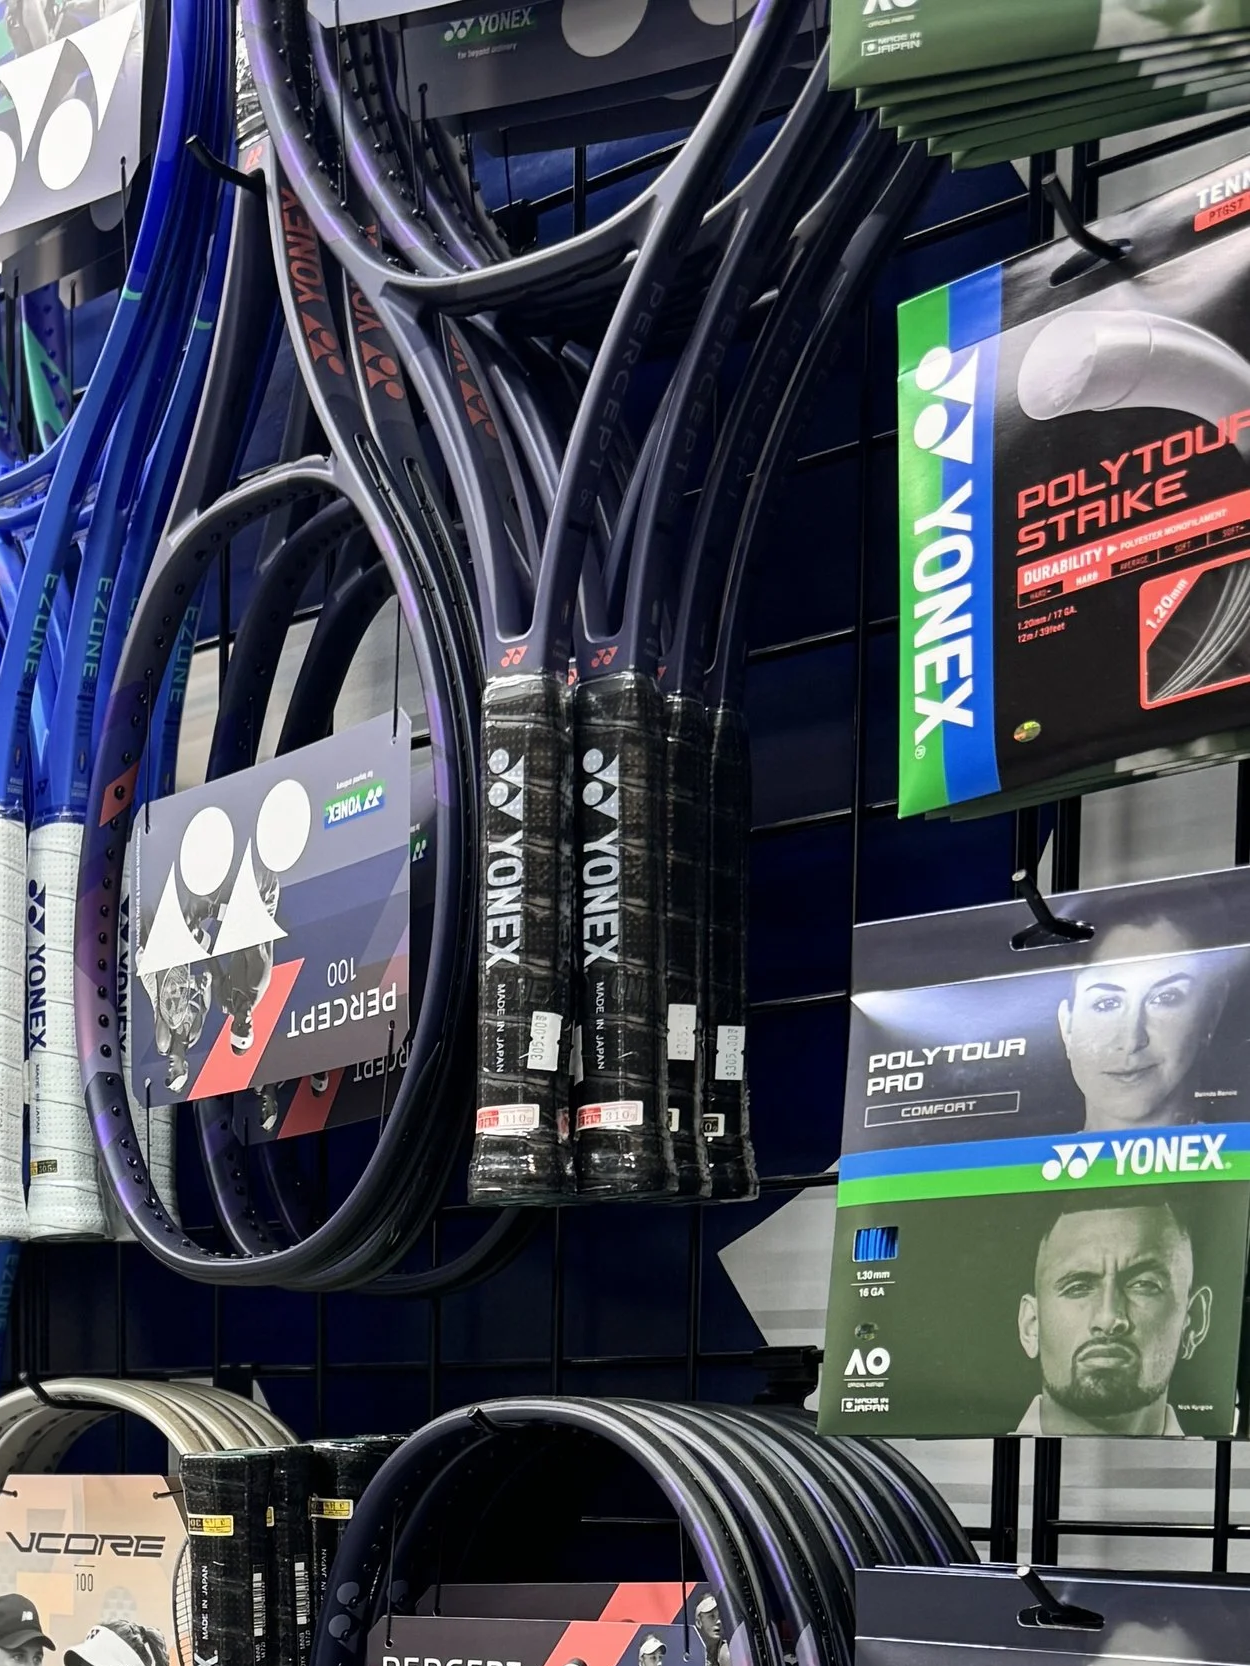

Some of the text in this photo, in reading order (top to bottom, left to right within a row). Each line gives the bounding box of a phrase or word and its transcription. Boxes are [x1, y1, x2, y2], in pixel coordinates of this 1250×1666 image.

[478, 7, 533, 35] YONEX
[878, 38, 921, 53] JAPAN
[589, 281, 666, 477] PERCEPT
[1016, 470, 1188, 556] STRIKE
[1023, 509, 1228, 586] DURABILITY POLYESTER MONOFILAMENT
[1075, 570, 1098, 586] HARD
[914, 479, 974, 742] YONEX
[1146, 577, 1188, 630] 1.20mm
[24, 573, 59, 674] EZONE
[83, 577, 113, 678] EZONE
[326, 793, 362, 824] YONEX
[486, 830, 524, 967] YONEX
[582, 830, 620, 967] YONEX
[328, 957, 356, 988] 100
[29, 943, 47, 1050] YONEX
[287, 982, 397, 1038] PERCEPT
[496, 983, 505, 1073] MADE IN JAPAN
[596, 982, 605, 1070] MADE IN JAPAN
[868, 1037, 1027, 1074] POLYTOUR
[866, 1072, 924, 1096] PRO
[900, 1100, 977, 1119] COMFORT
[1111, 1134, 1227, 1176] YONEX
[858, 1286, 885, 1297] 16 GA
[843, 1347, 891, 1376] AO
[854, 1403, 890, 1413] JAPAN
[5, 1531, 166, 1558] VCORE
[75, 1572, 94, 1592] 100
[320, 1549, 328, 1580] JAPAN
[202, 1598, 209, 1612] IN
